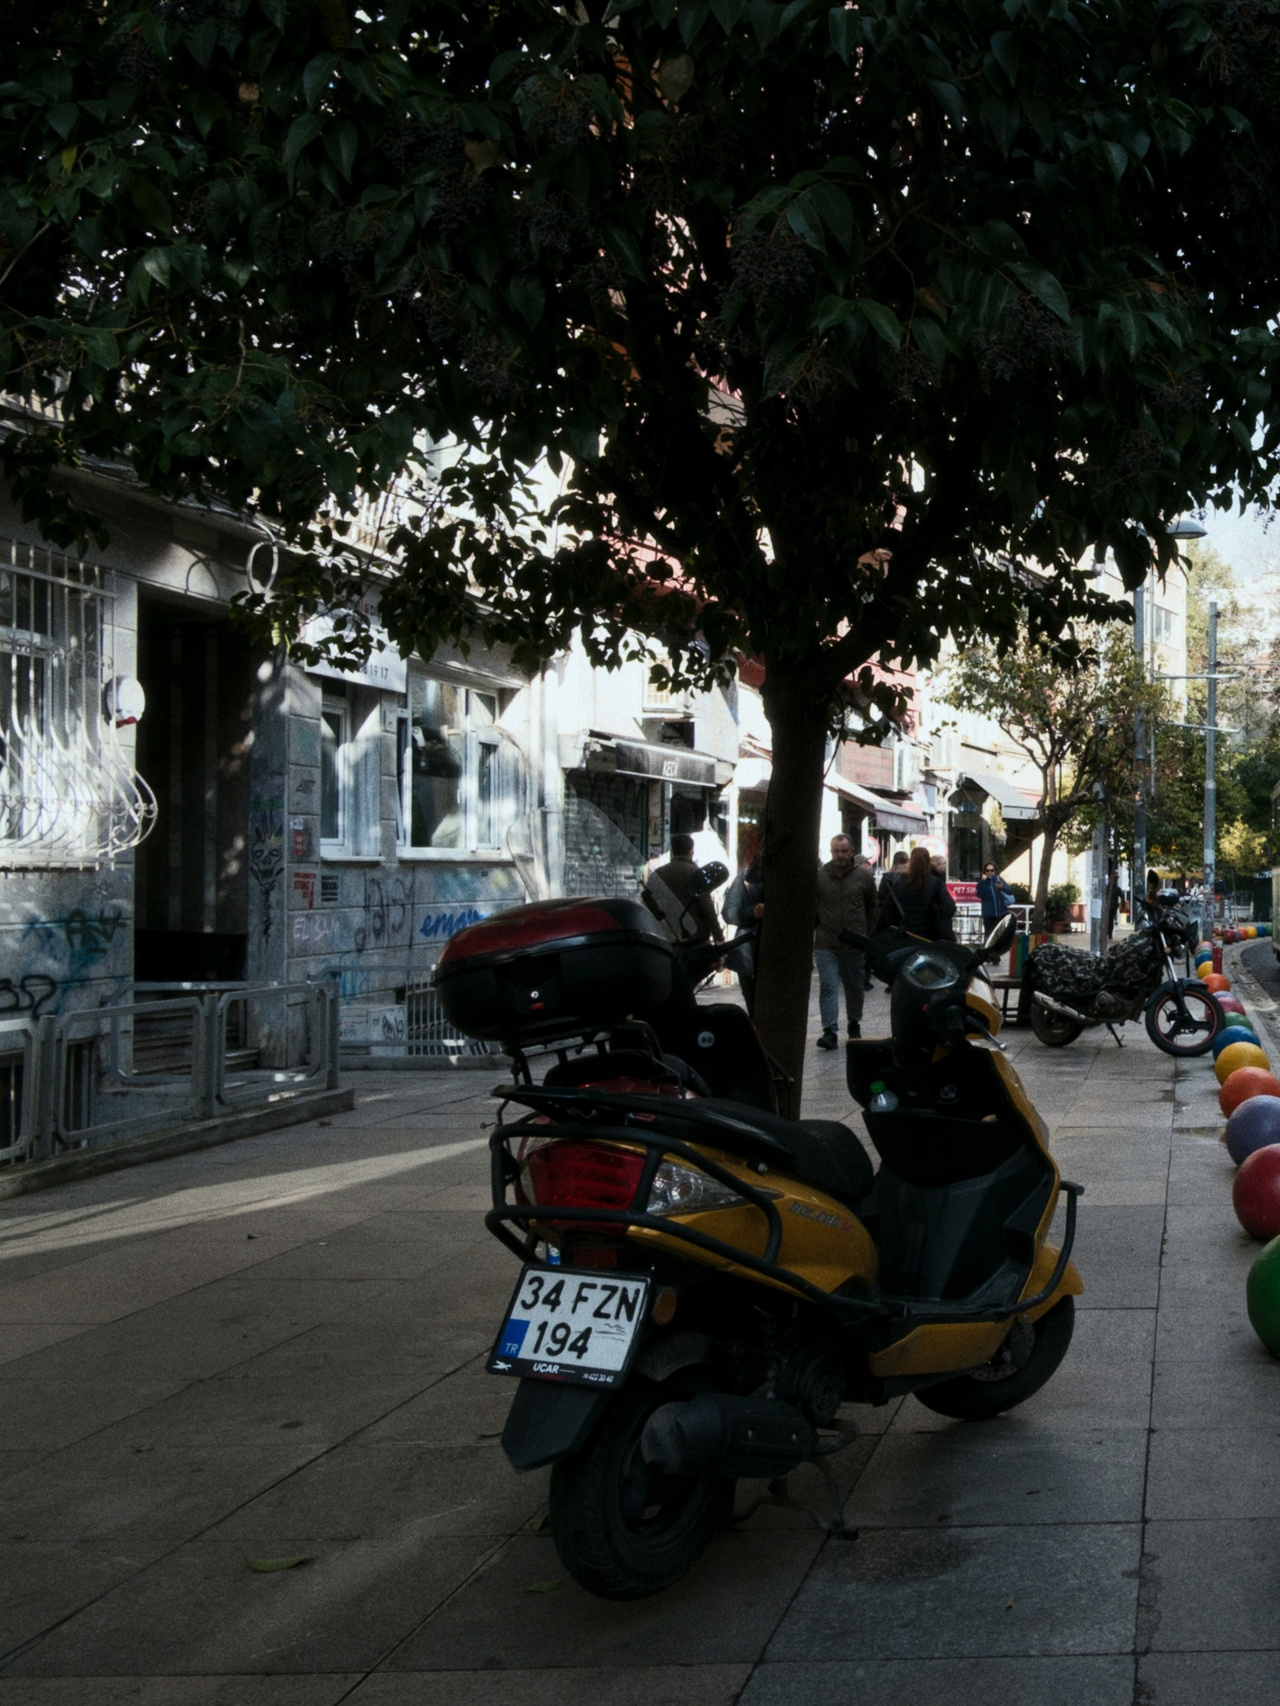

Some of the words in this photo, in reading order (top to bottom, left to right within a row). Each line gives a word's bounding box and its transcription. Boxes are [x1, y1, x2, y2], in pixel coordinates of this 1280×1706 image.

[952, 886, 966, 894] PET
[520, 1276, 565, 1313] 34
[571, 1282, 641, 1322] FZN
[504, 1342, 519, 1355] TR
[533, 1321, 592, 1359] 194
